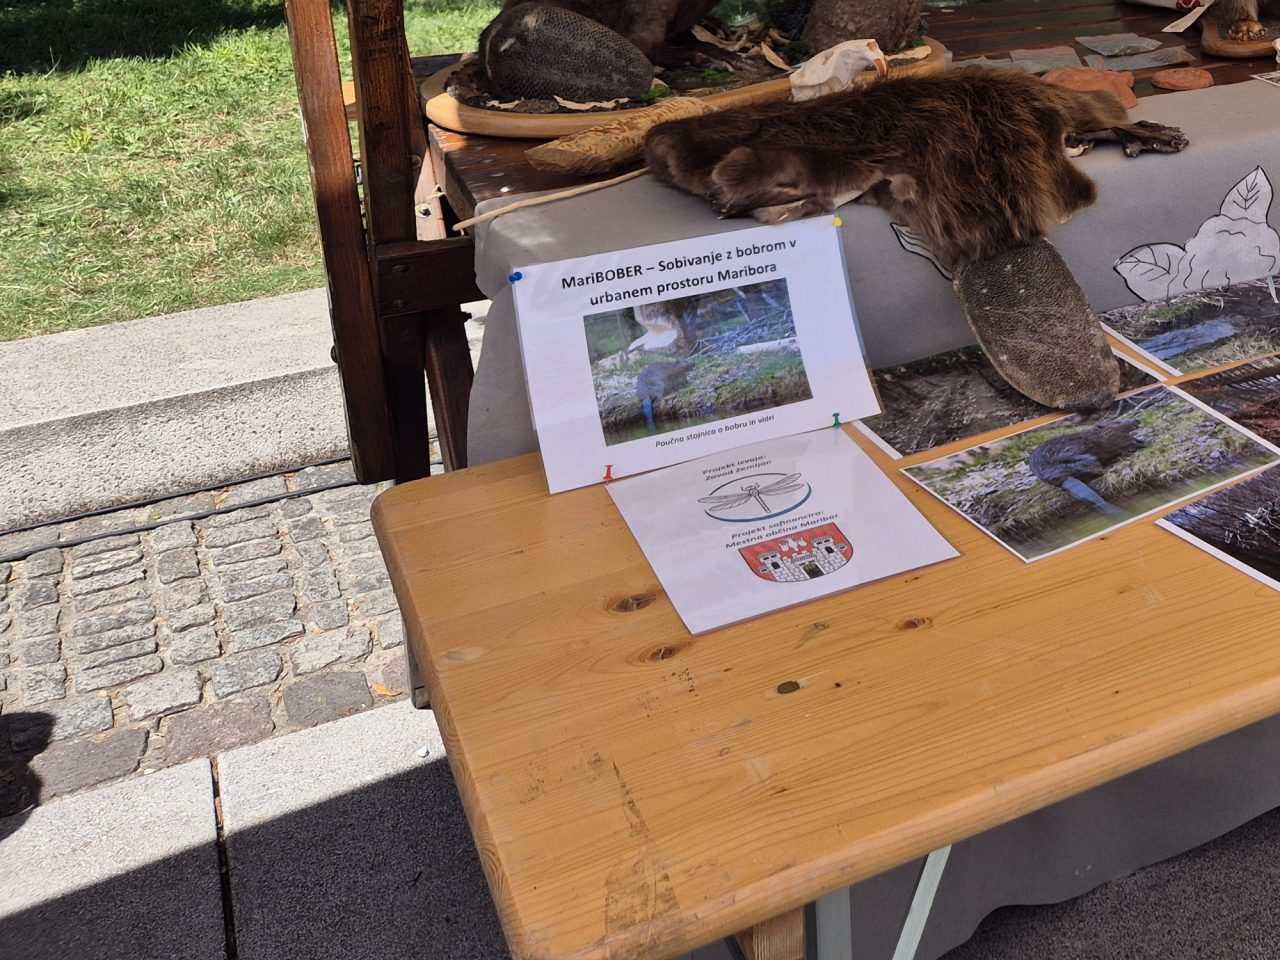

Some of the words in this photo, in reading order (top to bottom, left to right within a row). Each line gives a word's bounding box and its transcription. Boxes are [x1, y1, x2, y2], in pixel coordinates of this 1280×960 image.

[561, 264, 643, 290] MariBOBER
[658, 251, 723, 273] Sobivanje
[726, 250, 733, 260] z
[736, 240, 786, 259] bobrom
[789, 239, 797, 248] v
[590, 286, 653, 306] urbanem
[657, 274, 714, 296] prostoru
[718, 262, 777, 282] Maribora
[655, 436, 685, 448] Poučna
[686, 429, 716, 442] stojnica
[725, 421, 748, 432] bobru
[749, 419, 757, 427] in
[758, 413, 775, 424] vidri
[725, 533, 764, 549] Mestna
[765, 525, 798, 538] občina
[800, 513, 839, 528] Maribor
[731, 526, 767, 540] Projekt
